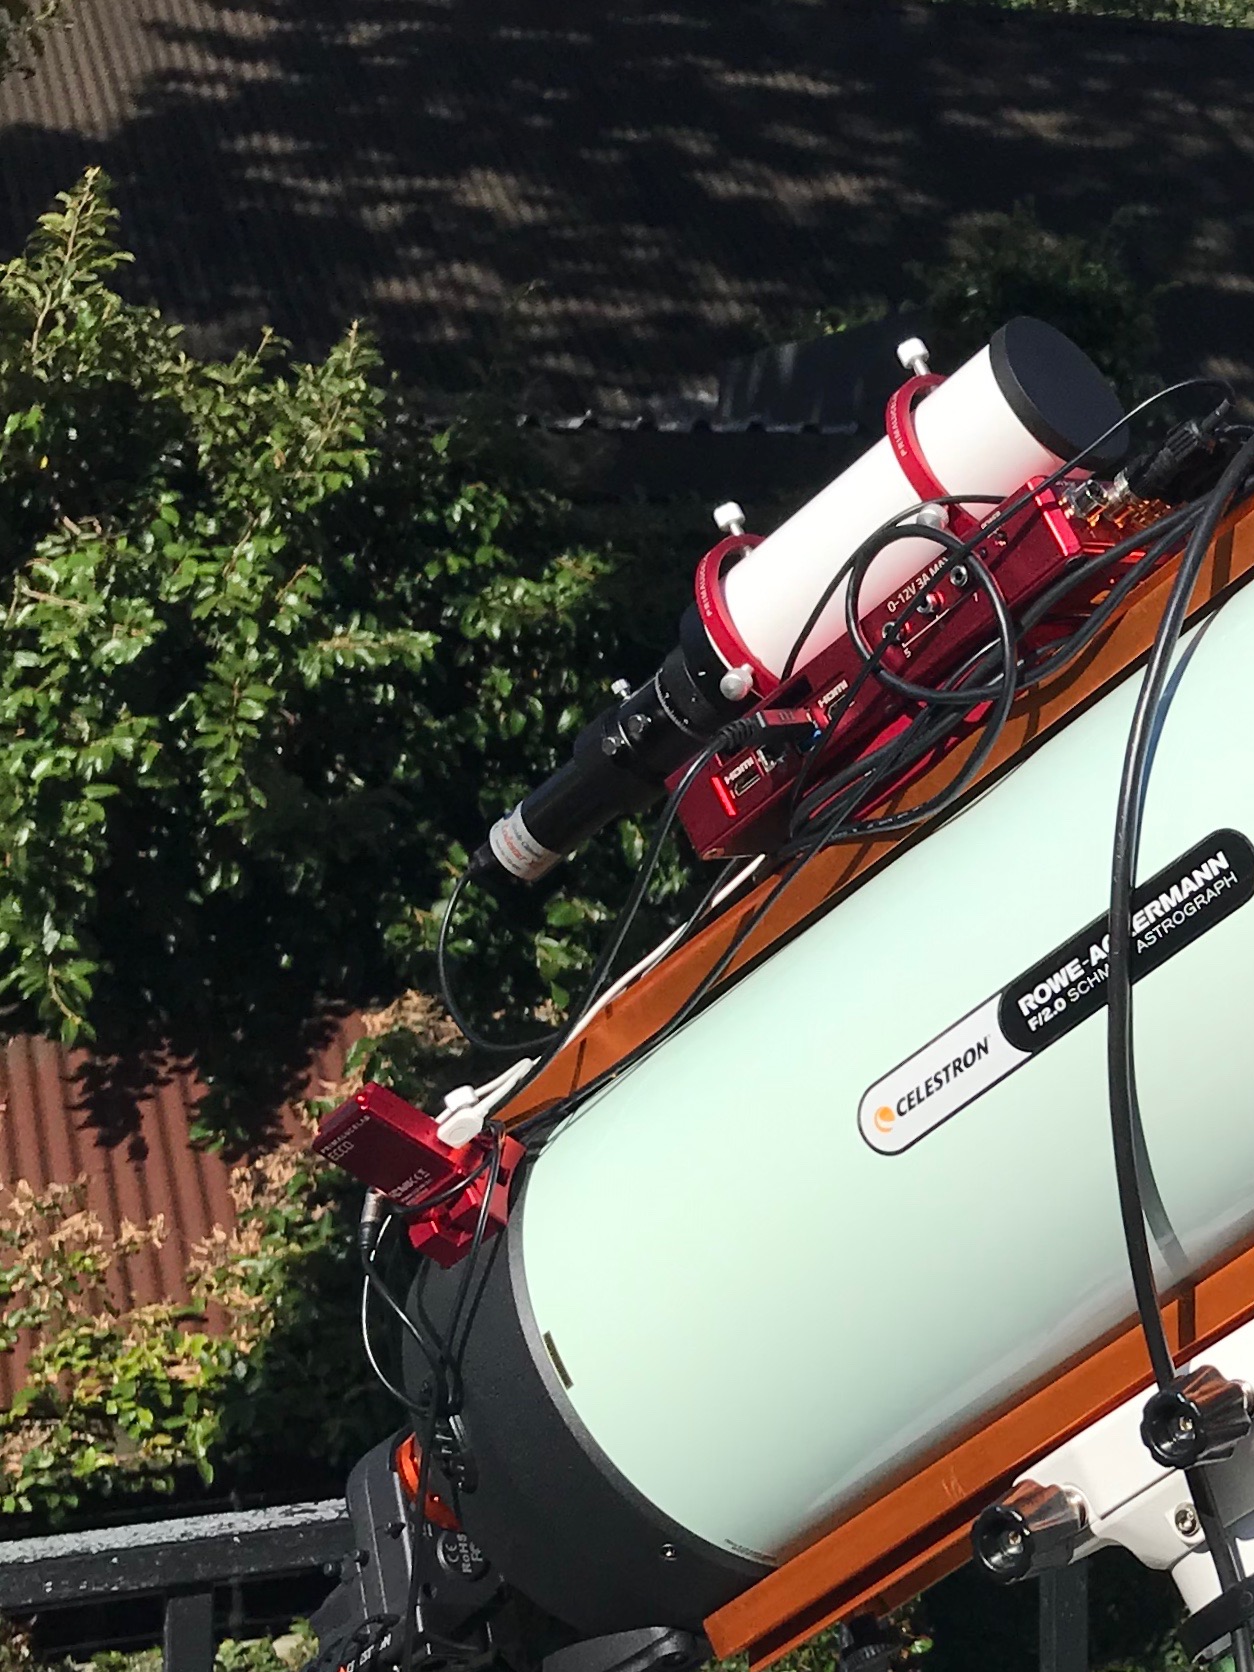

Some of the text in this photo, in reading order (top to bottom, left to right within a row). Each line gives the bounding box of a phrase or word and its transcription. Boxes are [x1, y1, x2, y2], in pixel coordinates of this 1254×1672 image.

[886, 556, 948, 613] 0-12V 3A MA
[903, 648, 912, 659] 5
[817, 679, 849, 708] HDMI
[723, 756, 755, 785] HDMI
[1027, 870, 1239, 1032] F/2.0 SCHM ASTROGRAPH
[896, 1036, 990, 1117] CELESTRON
[456, 1533, 473, 1573] RoHS
